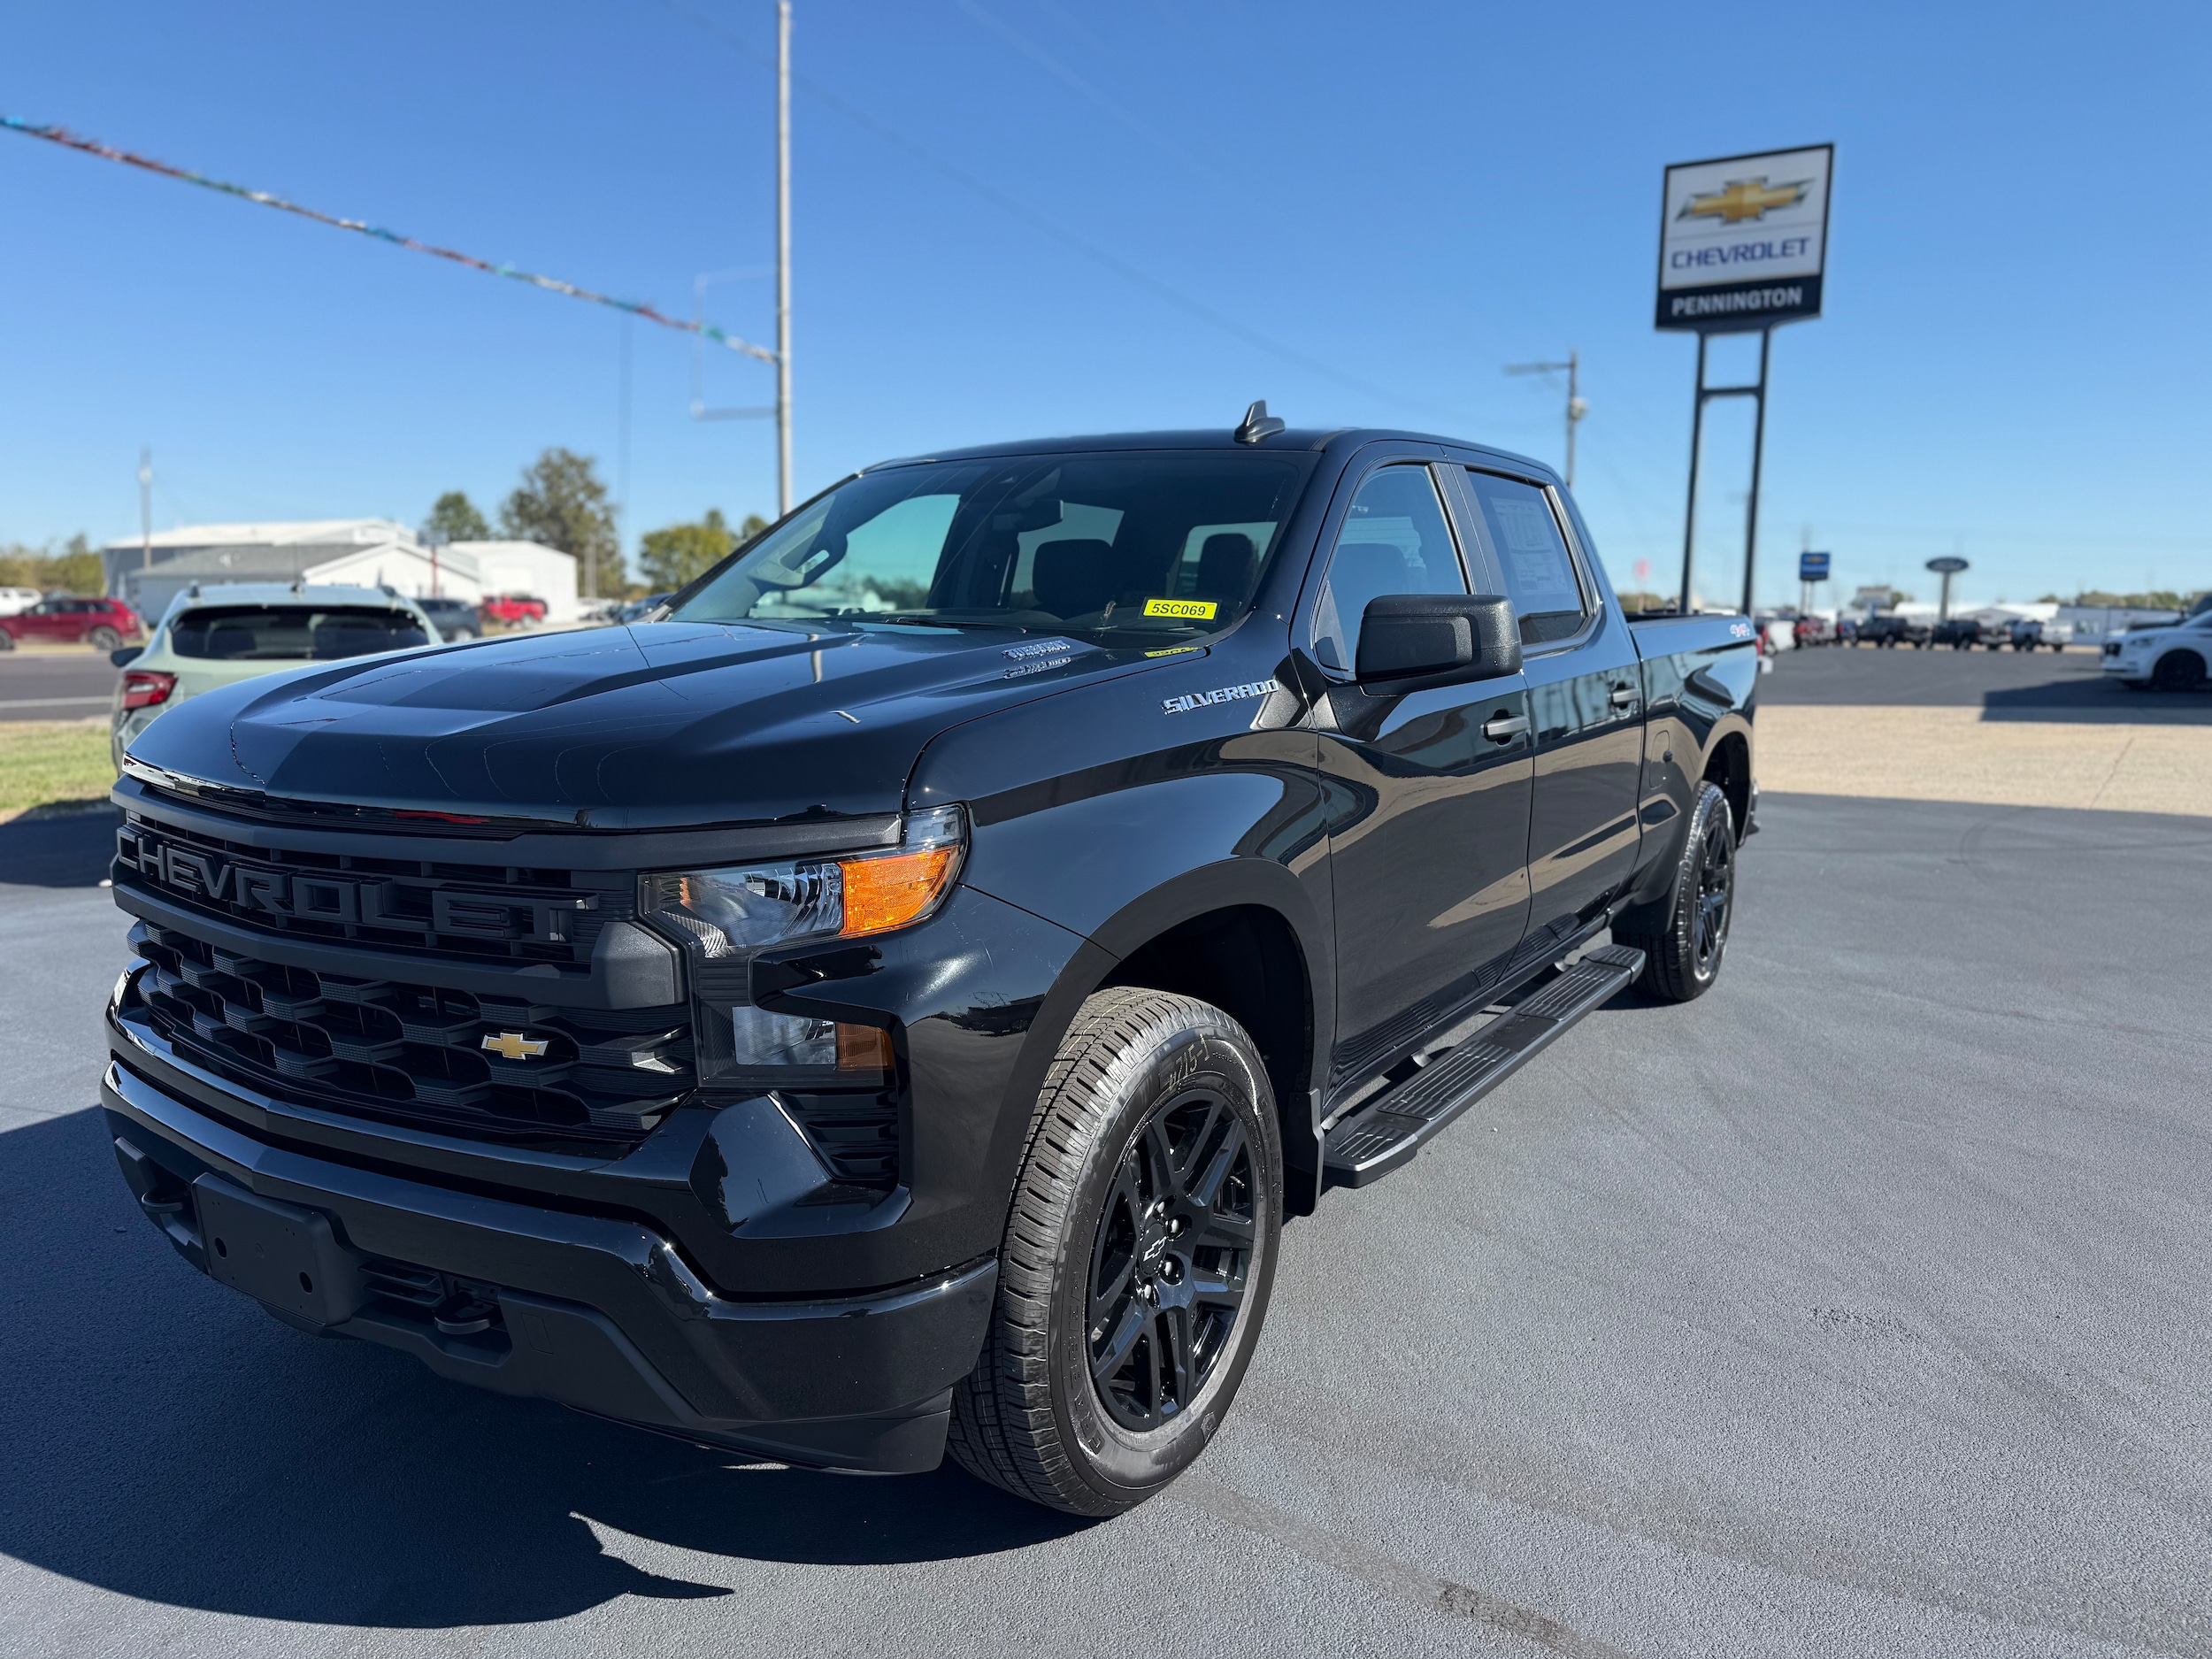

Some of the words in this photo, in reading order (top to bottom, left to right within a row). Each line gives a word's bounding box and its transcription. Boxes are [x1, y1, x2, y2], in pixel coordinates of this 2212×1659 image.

[1671, 236, 1810, 270] CHEVROLET
[1671, 287, 1803, 317] PENNINGTON
[1151, 603, 1206, 616] 5SC069
[1161, 679, 1279, 714] SILVERADO
[115, 823, 599, 944] CHEVROLET
